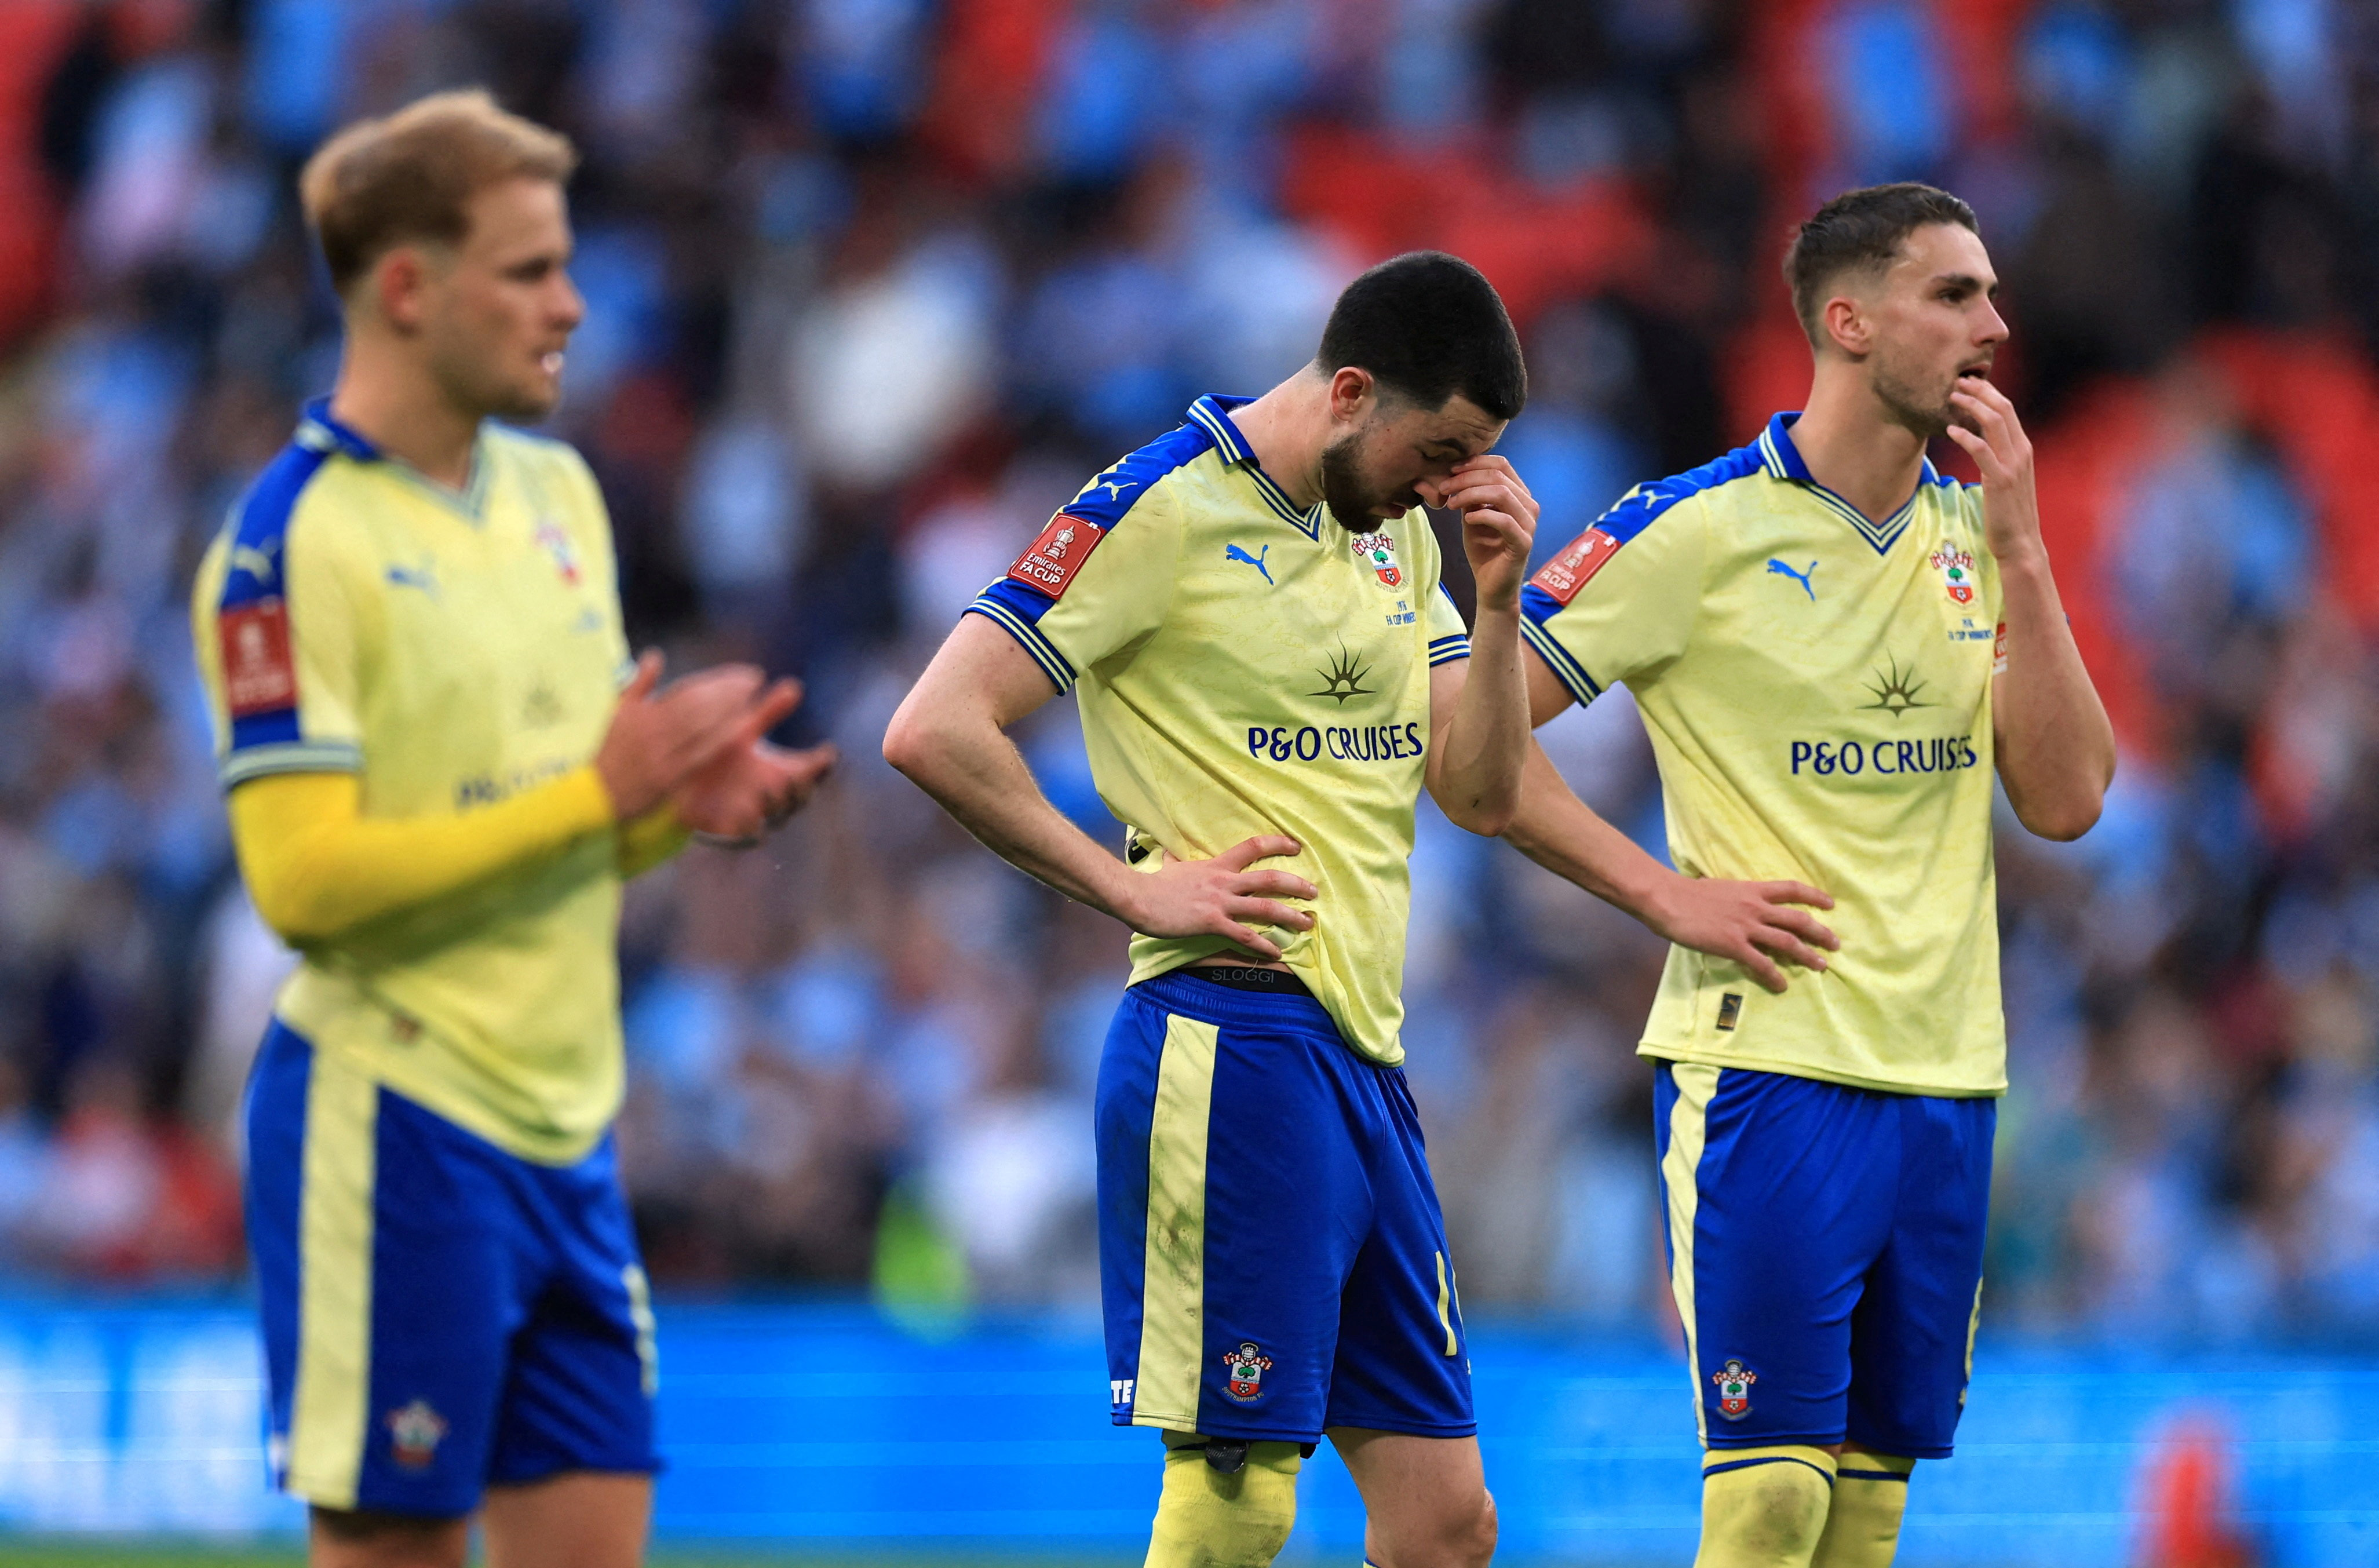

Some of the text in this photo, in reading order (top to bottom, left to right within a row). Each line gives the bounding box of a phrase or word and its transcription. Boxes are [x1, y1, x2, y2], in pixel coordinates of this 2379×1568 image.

[1019, 562, 1060, 584] FA CUP
[1027, 553, 1066, 576] Emirates
[1548, 574, 1570, 590] CUP
[1393, 614, 1402, 625] CUP
[1248, 723, 1423, 761] P&O CRUISES
[1791, 741, 1864, 775] P&O
[1212, 969, 1274, 983] SLOGGI
[1111, 1380, 1133, 1403] TE
